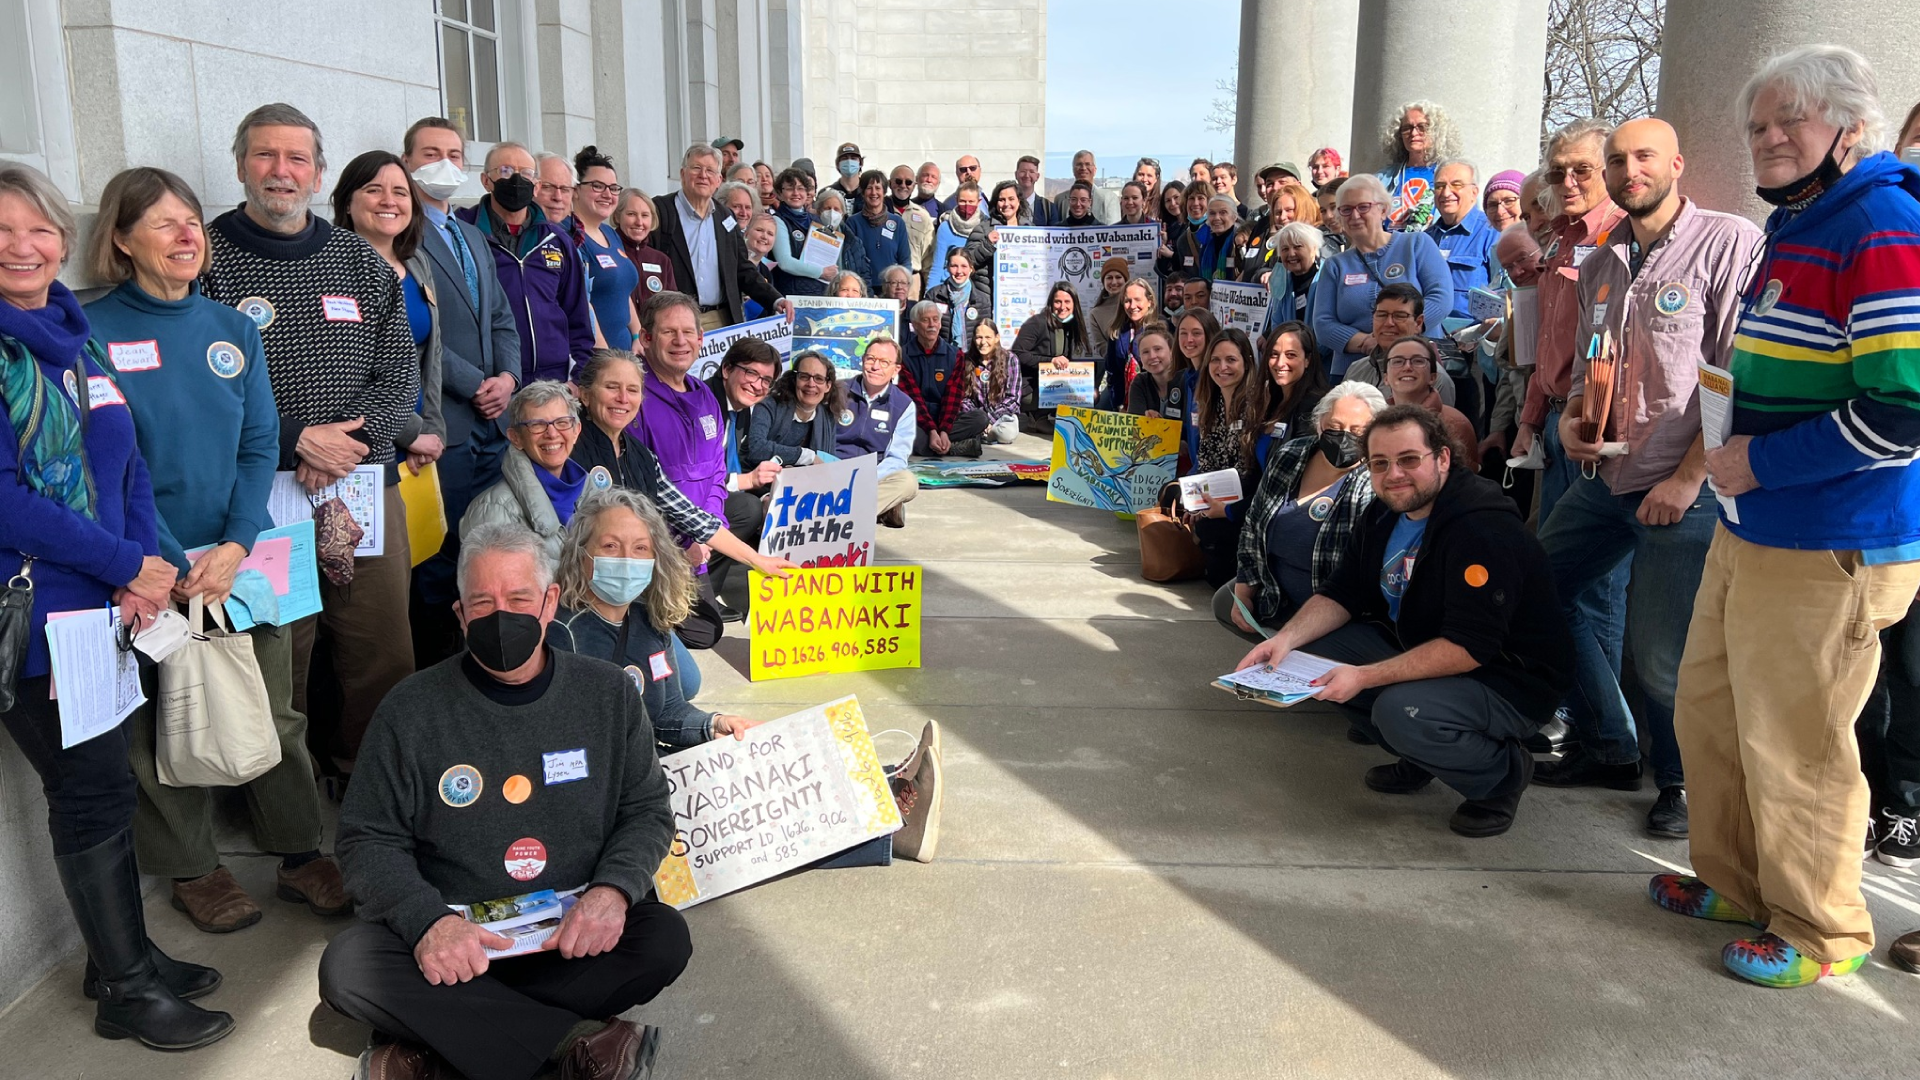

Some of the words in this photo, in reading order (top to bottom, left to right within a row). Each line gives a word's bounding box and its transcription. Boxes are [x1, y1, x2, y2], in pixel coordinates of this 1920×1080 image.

[1001, 233, 1020, 243] We
[1022, 233, 1051, 244] stand
[1052, 233, 1076, 244] with
[1077, 232, 1094, 244] the
[1095, 230, 1155, 243] Wabanaki.
[798, 299, 823, 308] STAND
[825, 299, 844, 308] WITH
[847, 300, 889, 309] WABANAKI
[709, 338, 727, 356] the
[115, 353, 156, 367] Stewart
[1070, 408, 1087, 418] THE
[767, 523, 805, 553] with
[808, 517, 854, 543] the
[759, 573, 844, 602] STAND
[853, 571, 915, 593] WITH
[756, 604, 912, 636] WABANAKI
[763, 647, 787, 668] LD
[662, 751, 735, 796] STAND
[670, 780, 823, 858] SOVEREIGNTY
[694, 838, 754, 870] SUPPORT
[759, 831, 775, 848] LD
[819, 810, 848, 831] 906
[751, 853, 769, 866] and
[774, 843, 799, 864] 585
